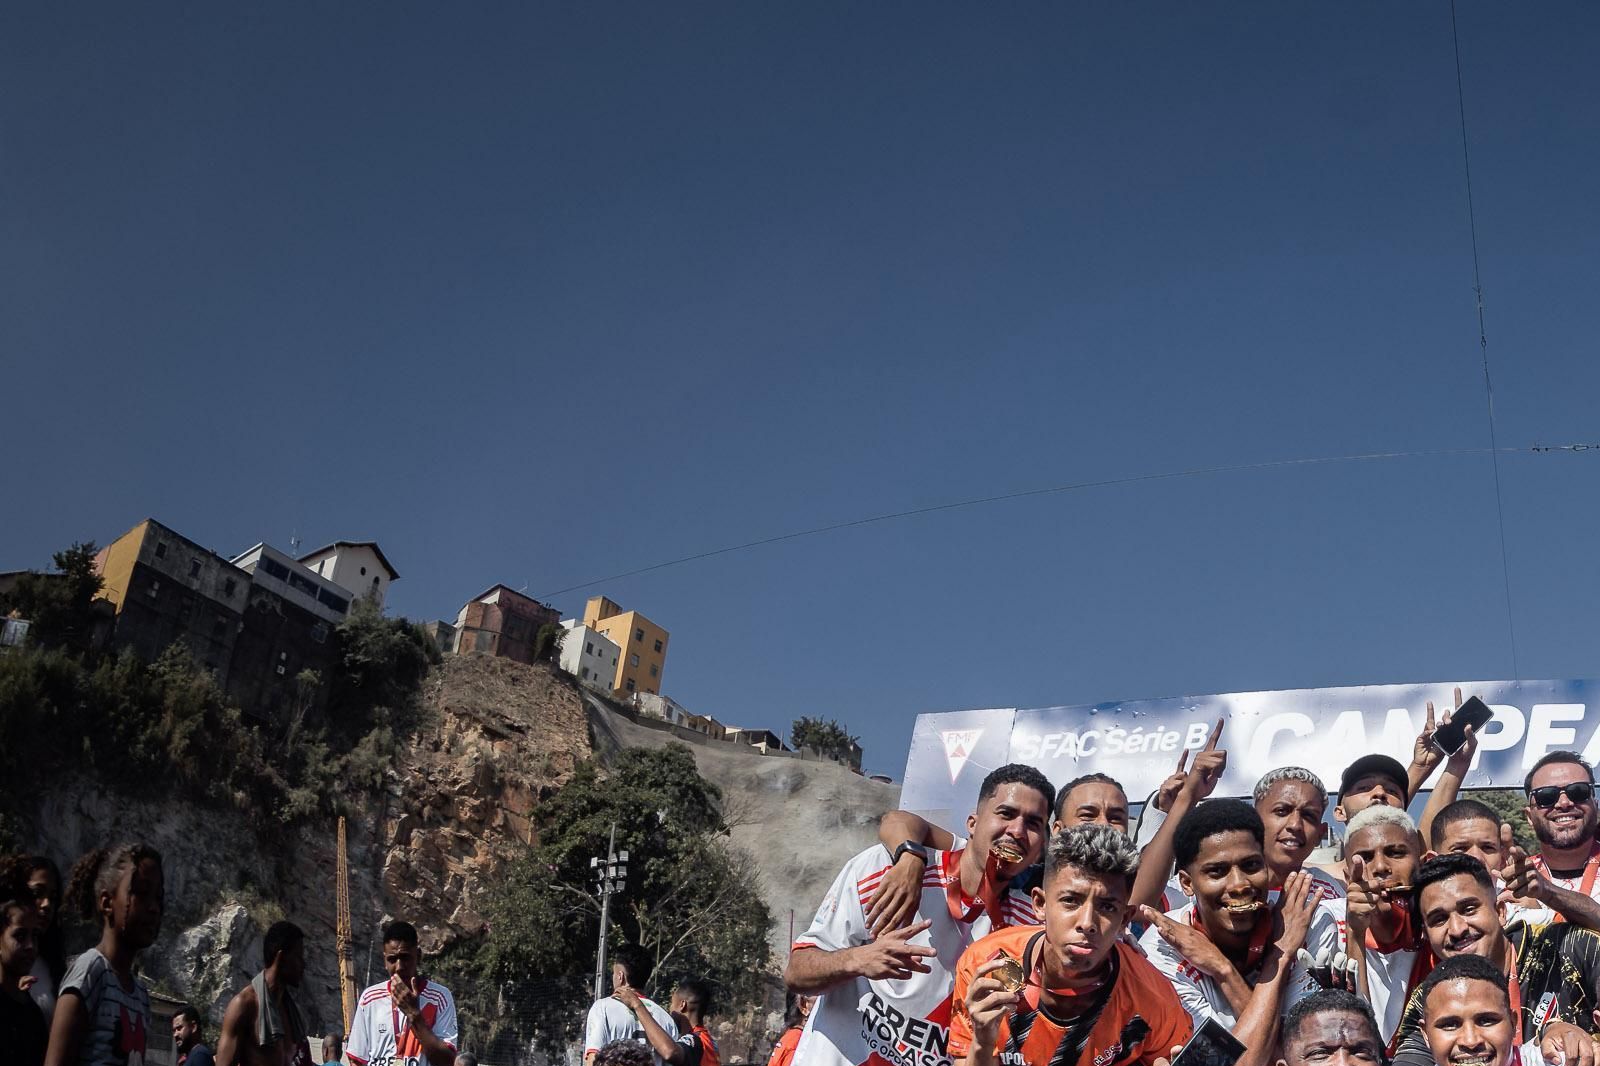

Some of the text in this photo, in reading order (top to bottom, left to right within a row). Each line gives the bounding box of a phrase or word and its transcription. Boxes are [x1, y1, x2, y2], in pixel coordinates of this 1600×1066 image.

[1016, 723, 1210, 761] SFAC Série B
[867, 993, 951, 1058] BREN
